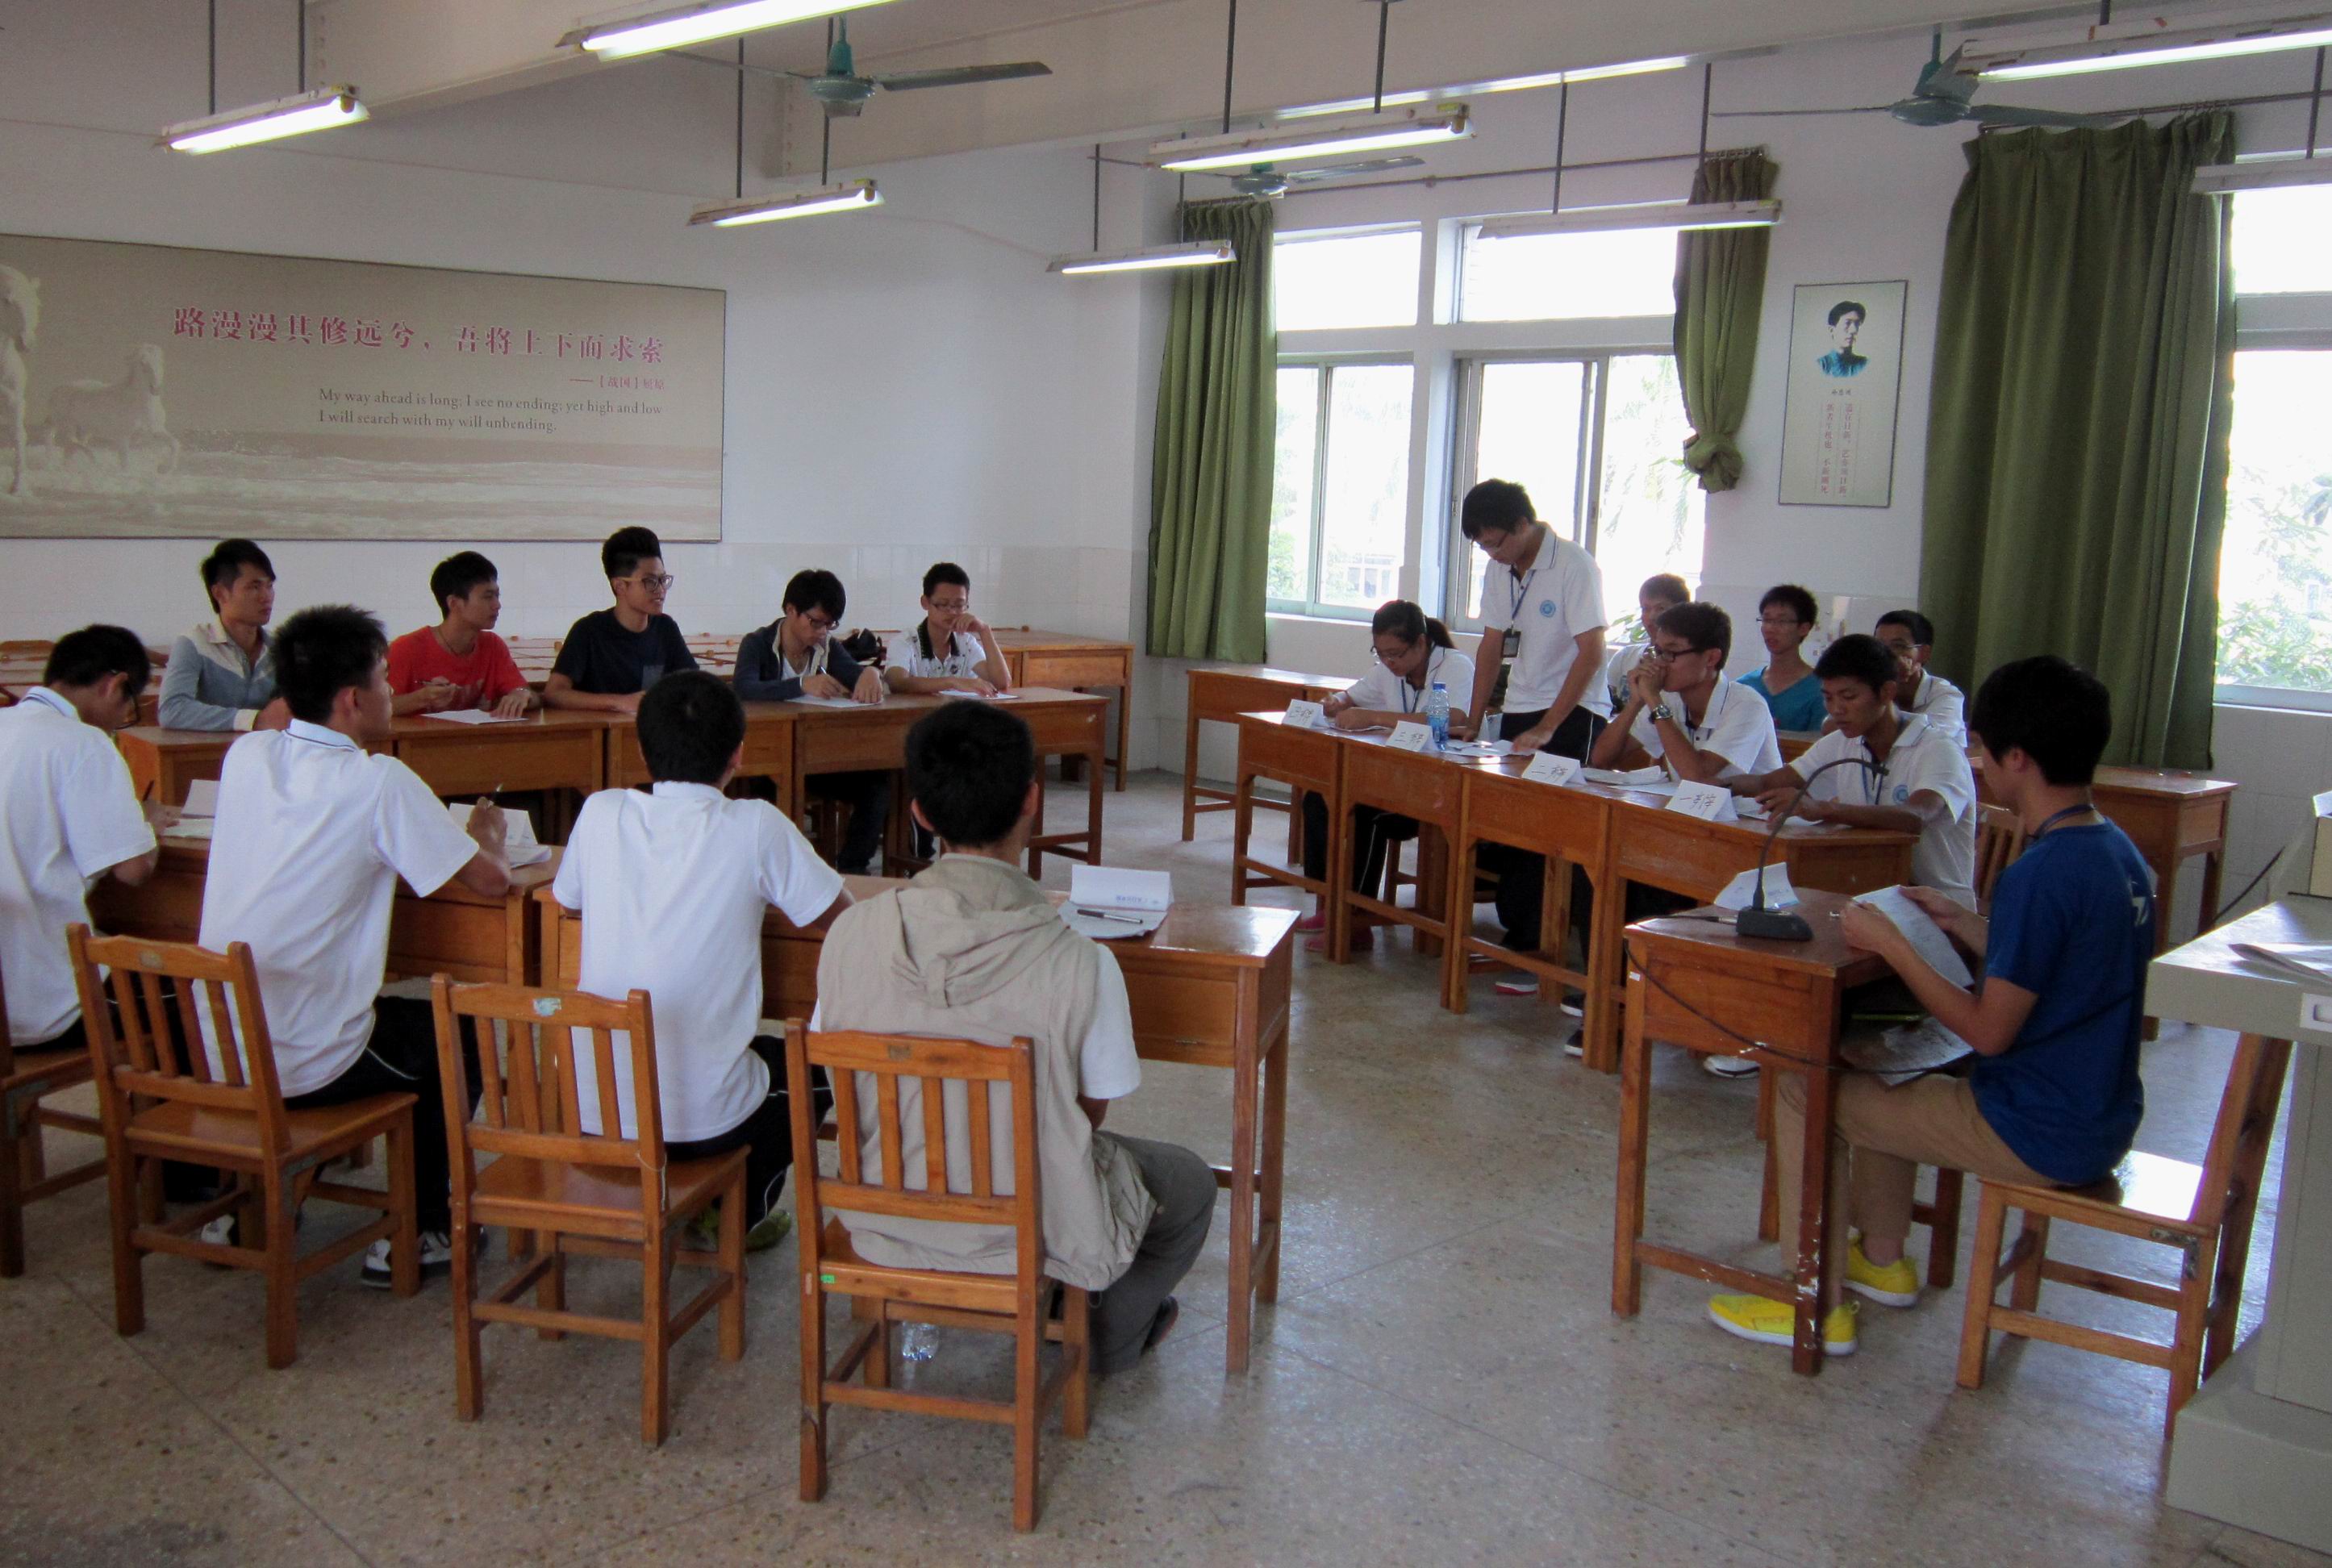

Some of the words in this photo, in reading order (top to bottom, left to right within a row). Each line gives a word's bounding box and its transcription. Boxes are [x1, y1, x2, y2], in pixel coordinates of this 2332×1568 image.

[319, 388, 340, 404] My
[344, 391, 370, 406] way
[374, 390, 412, 404] ahead
[416, 393, 427, 405] is
[430, 392, 462, 410] long;
[467, 394, 471, 407] I
[474, 398, 494, 407] see
[497, 398, 512, 408] no
[516, 397, 562, 413] ending;
[565, 401, 583, 414] yet
[587, 400, 613, 415] high
[617, 402, 638, 414] and
[642, 402, 661, 415] low
[319, 410, 324, 422] I
[328, 410, 353, 423] will
[357, 412, 398, 425] search
[403, 413, 432, 426] with
[436, 417, 454, 430] my
[459, 415, 482, 428] will
[486, 417, 557, 433] unbending.
